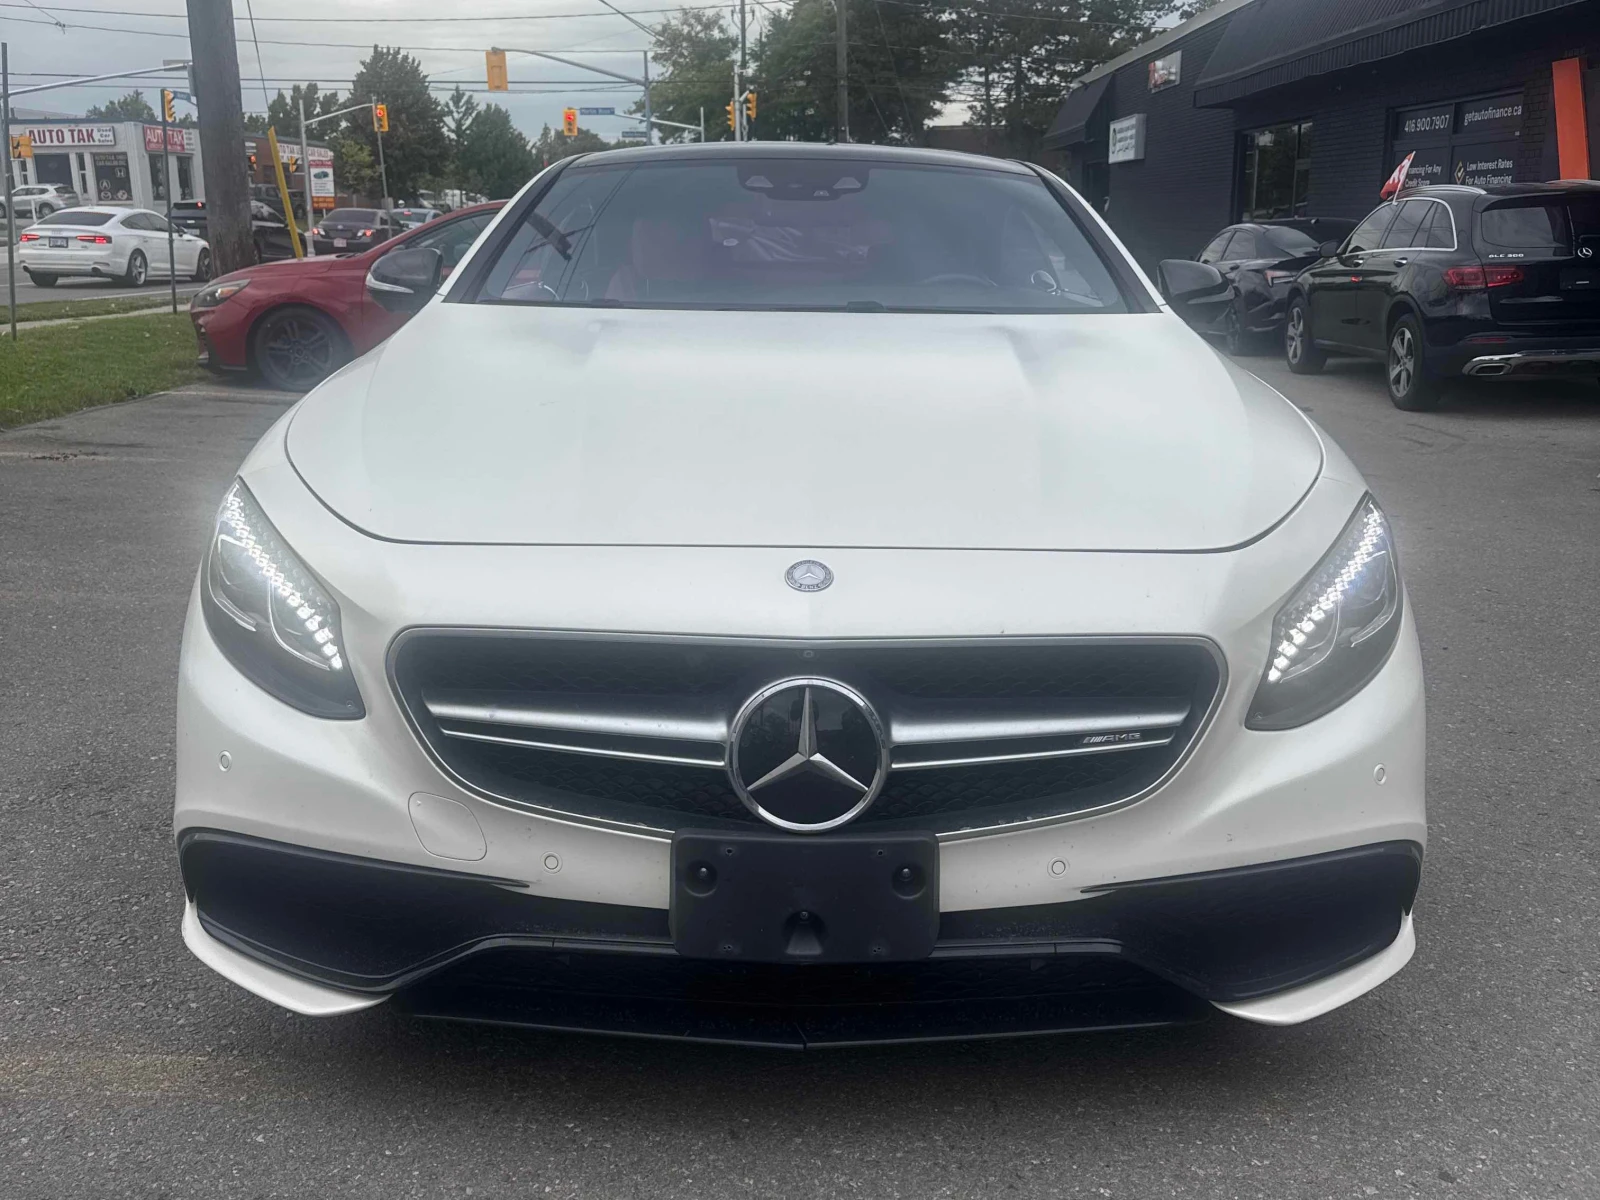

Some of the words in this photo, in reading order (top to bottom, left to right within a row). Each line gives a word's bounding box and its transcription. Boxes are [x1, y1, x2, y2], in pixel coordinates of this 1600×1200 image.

[1463, 104, 1522, 126] getautofinance.ca
[1404, 114, 1450, 133] 416.900.7907
[28, 129, 65, 144] AUTO
[68, 128, 96, 144] TAK
[146, 128, 164, 143] AUT
[166, 129, 184, 145] TAK
[1425, 165, 1433, 173] For
[1433, 165, 1442, 175] Any
[1466, 162, 1477, 171] Low
[1477, 161, 1497, 170] Interest
[1497, 160, 1513, 168] Rates
[1465, 175, 1474, 185] For
[1474, 175, 1486, 184] Auto
[1486, 174, 1512, 185] Financing
[1100, 732, 1141, 743] AMG
